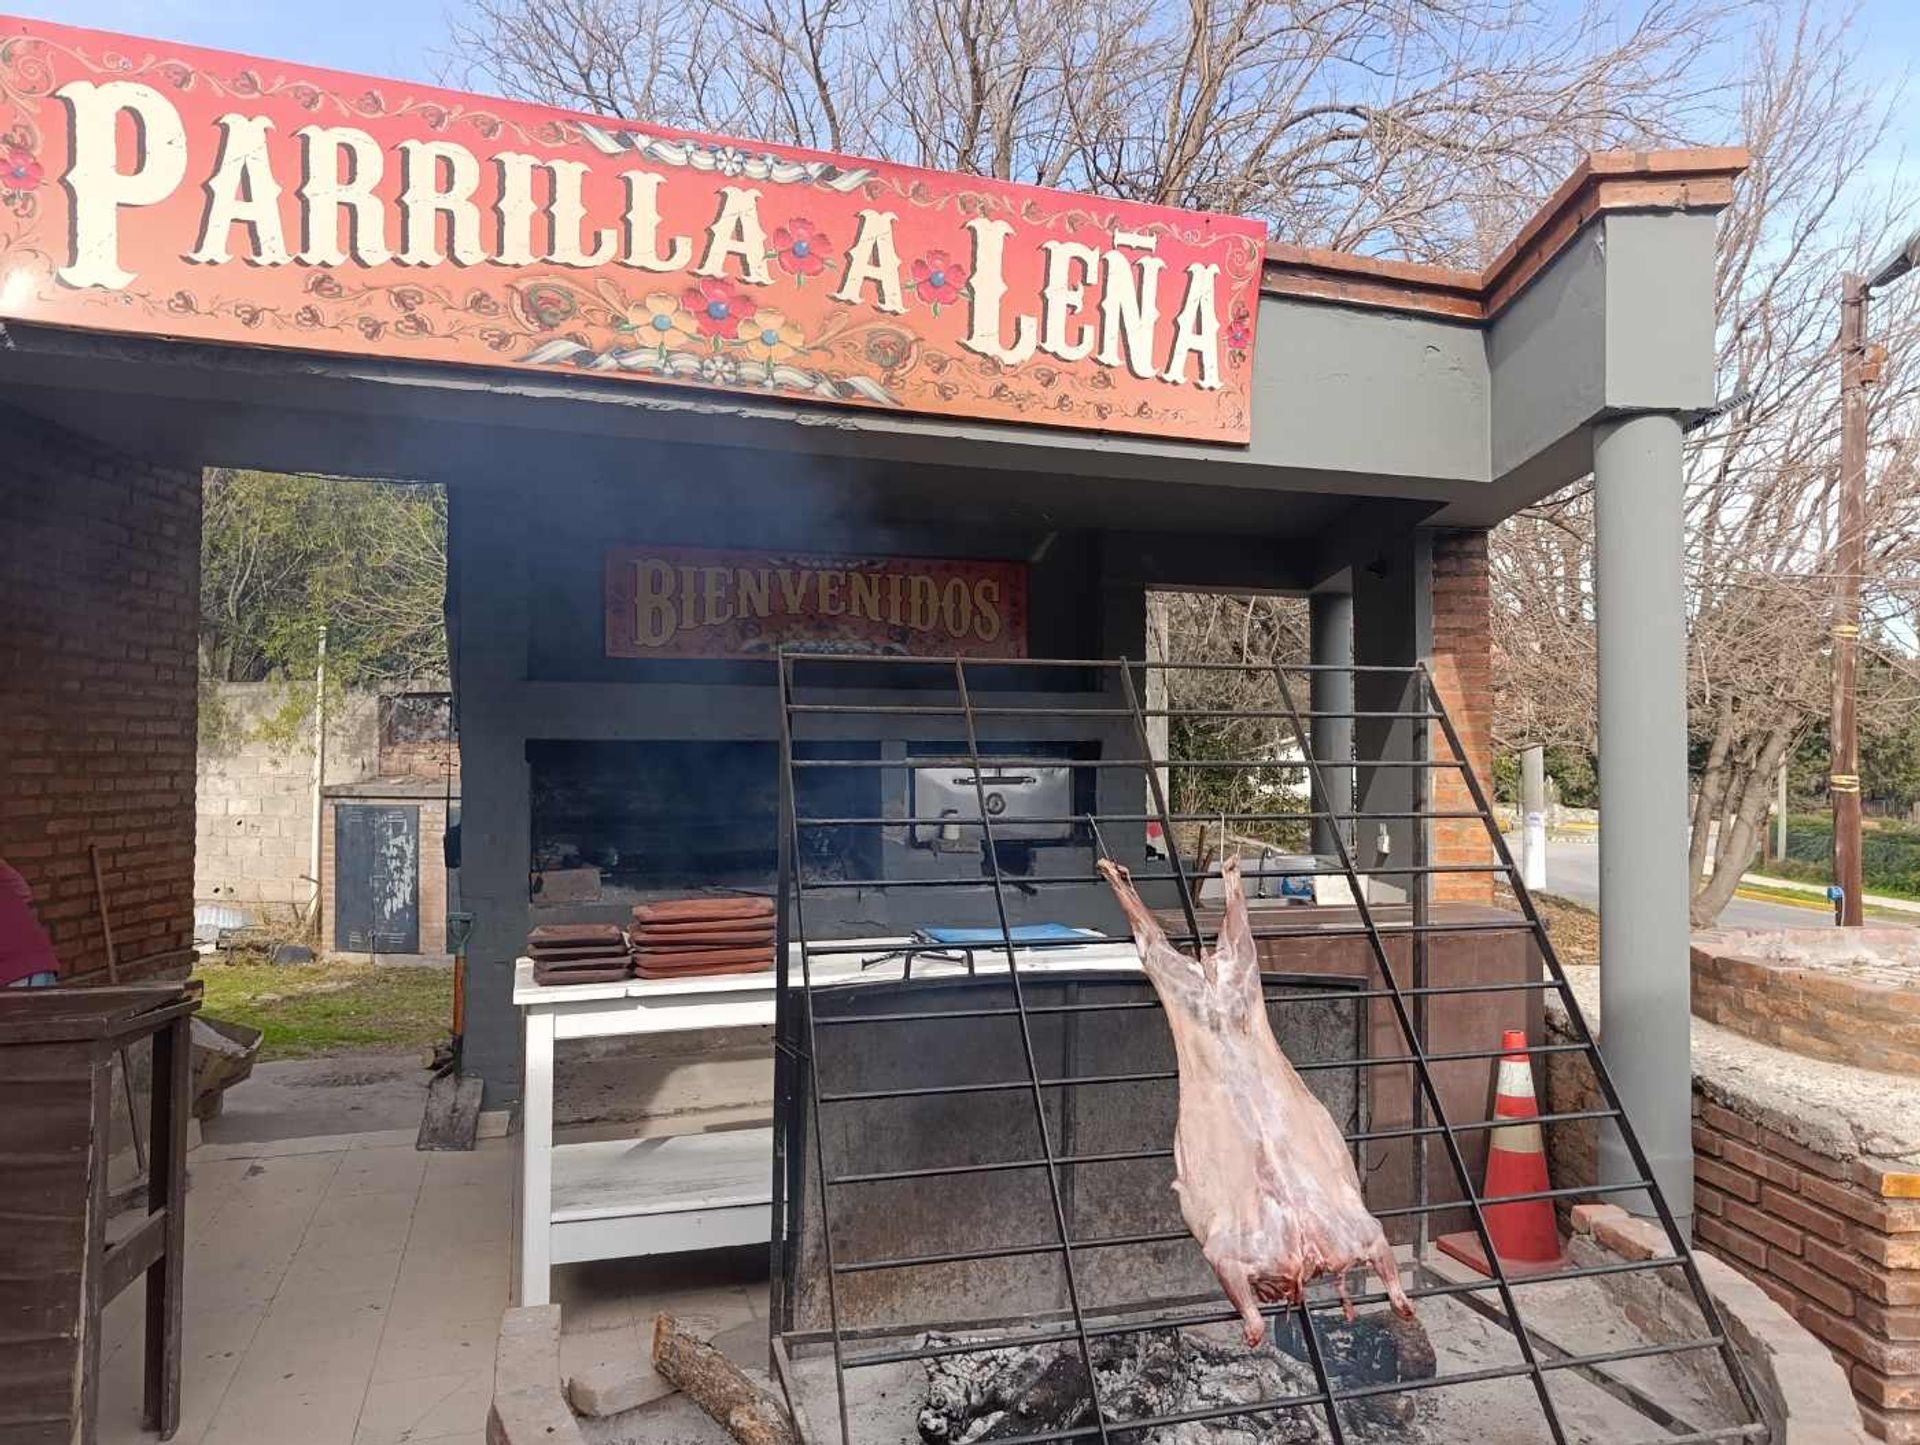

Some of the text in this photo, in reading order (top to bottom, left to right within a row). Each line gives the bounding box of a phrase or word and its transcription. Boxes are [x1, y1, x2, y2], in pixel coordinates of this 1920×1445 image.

[55, 81, 1223, 391] PARRILLA A LEÑA
[630, 556, 1001, 648] BIENVENIDOS
